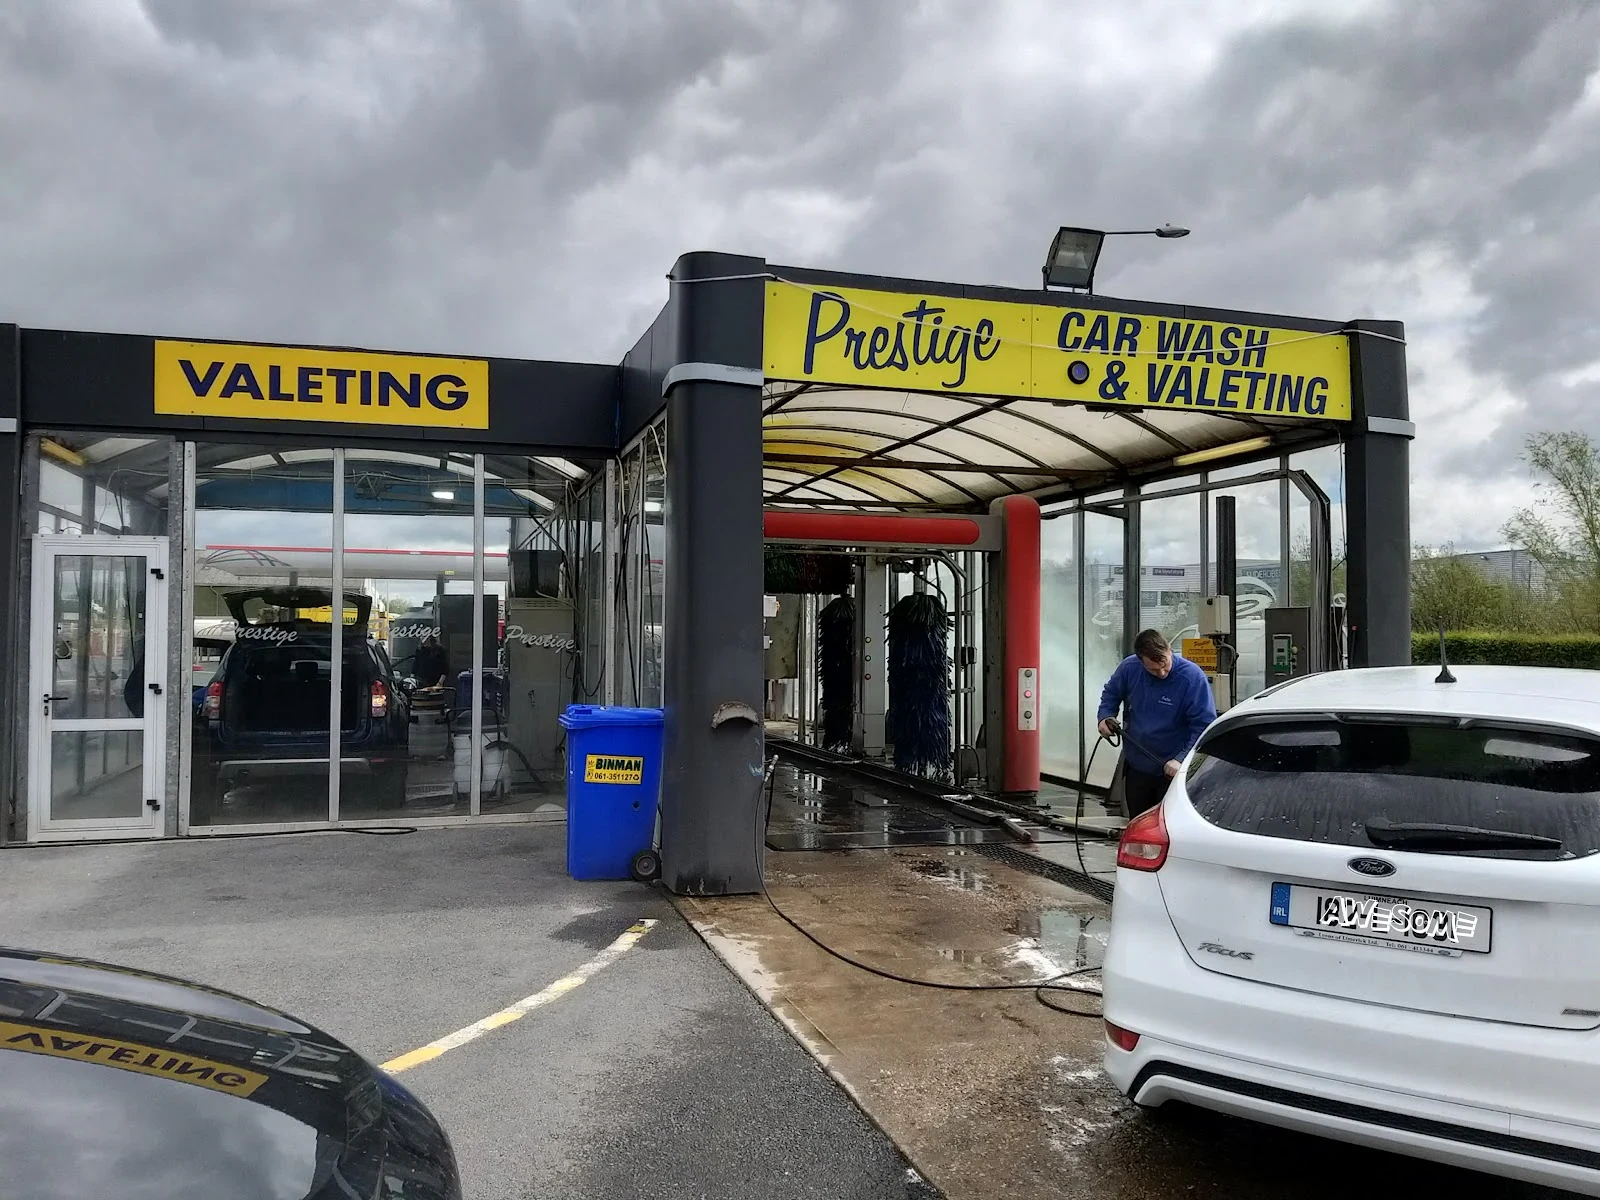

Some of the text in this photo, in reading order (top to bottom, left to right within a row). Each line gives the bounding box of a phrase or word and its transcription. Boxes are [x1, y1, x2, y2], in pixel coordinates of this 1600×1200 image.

[803, 291, 1000, 389] Prestige
[1057, 311, 1271, 368] CAR WASH
[178, 358, 470, 412] VALETING
[1099, 360, 1329, 416] & VALETING
[221, 619, 298, 648] Prestige
[505, 625, 575, 653] Prestige
[594, 773, 633, 781] 061-351127
[595, 758, 641, 771] BINMAN
[1357, 860, 1386, 873] Ford
[1273, 906, 1287, 917] IRL
